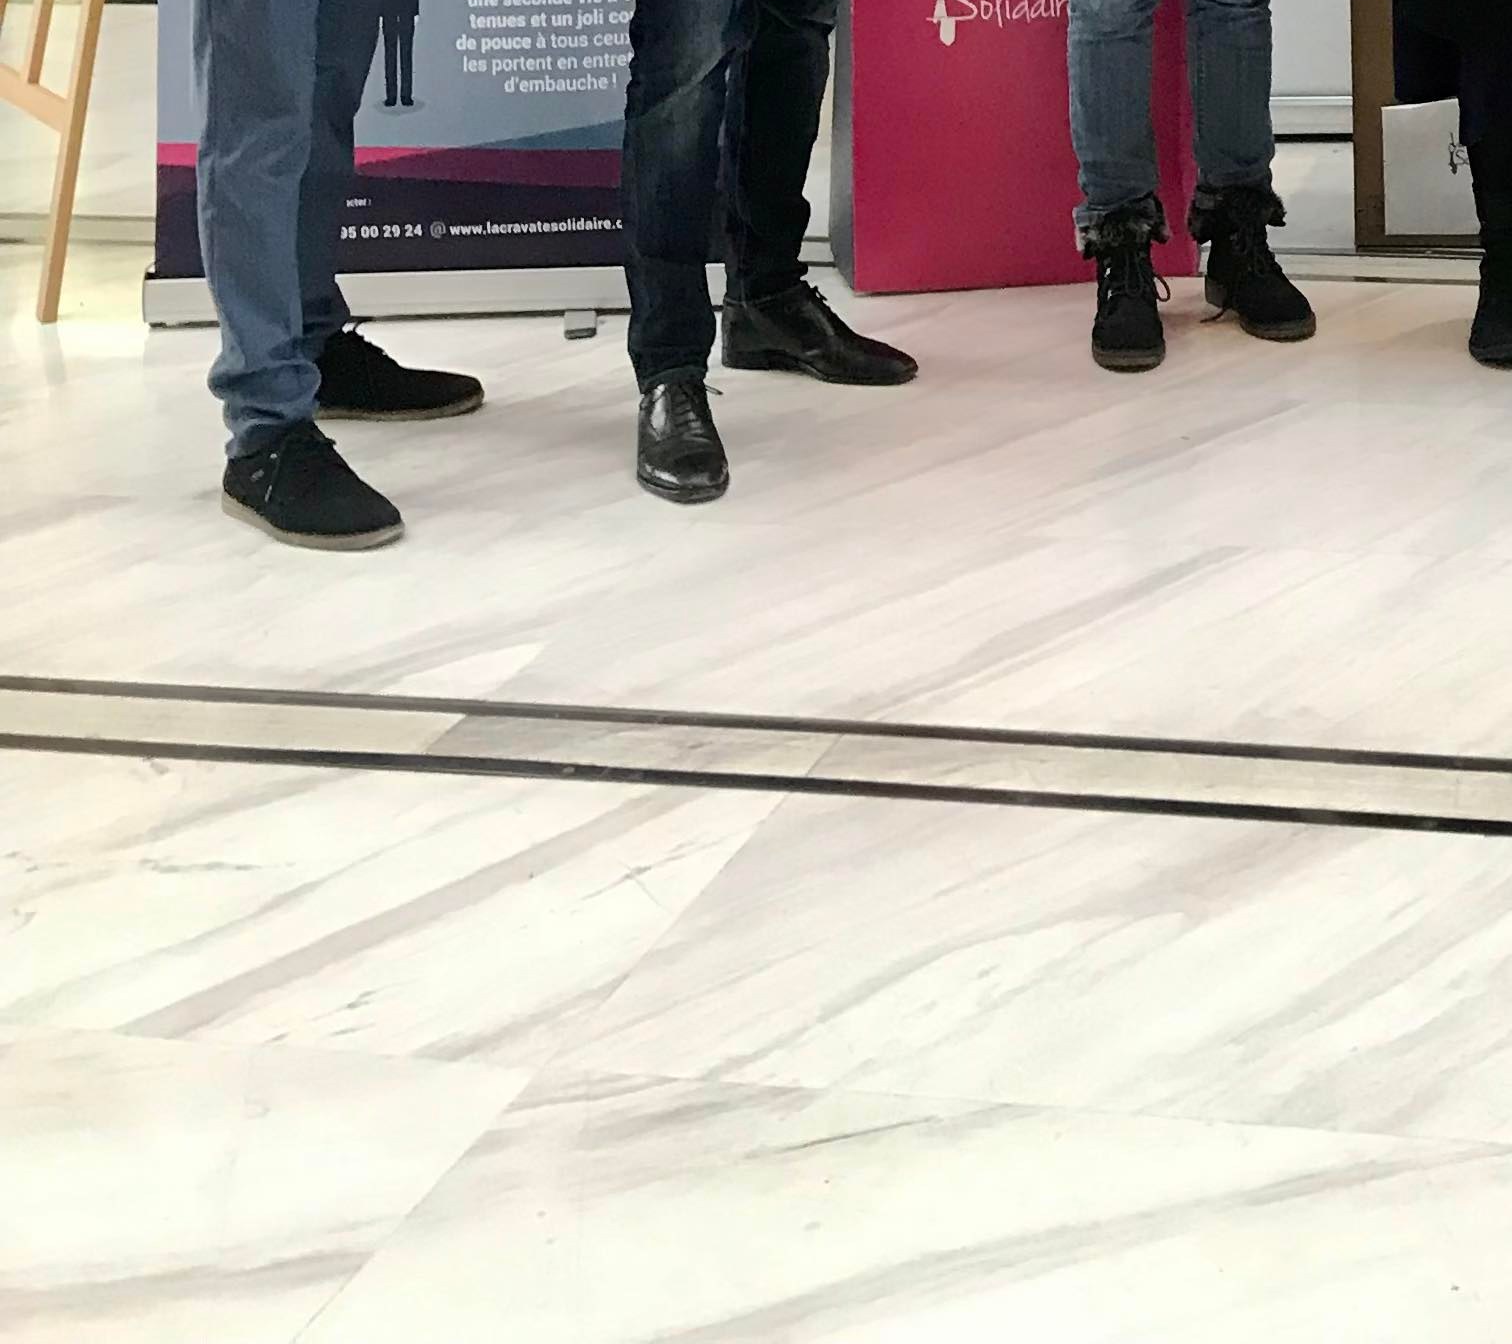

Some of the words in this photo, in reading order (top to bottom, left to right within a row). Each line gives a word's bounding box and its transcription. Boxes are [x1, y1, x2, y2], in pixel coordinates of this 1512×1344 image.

[470, 13, 526, 29] tenues
[530, 13, 547, 27] et
[551, 13, 573, 26] un
[575, 8, 604, 29] joli
[455, 34, 476, 51] de
[480, 36, 532, 53] pouce
[536, 32, 547, 49] à
[551, 33, 589, 48] tous
[462, 55, 487, 72] les
[491, 56, 553, 75] portent
[557, 55, 578, 70] en
[504, 73, 608, 93] d'embauche
[360, 225, 380, 238] 00
[383, 224, 400, 238] 29
[405, 224, 422, 237] 24
